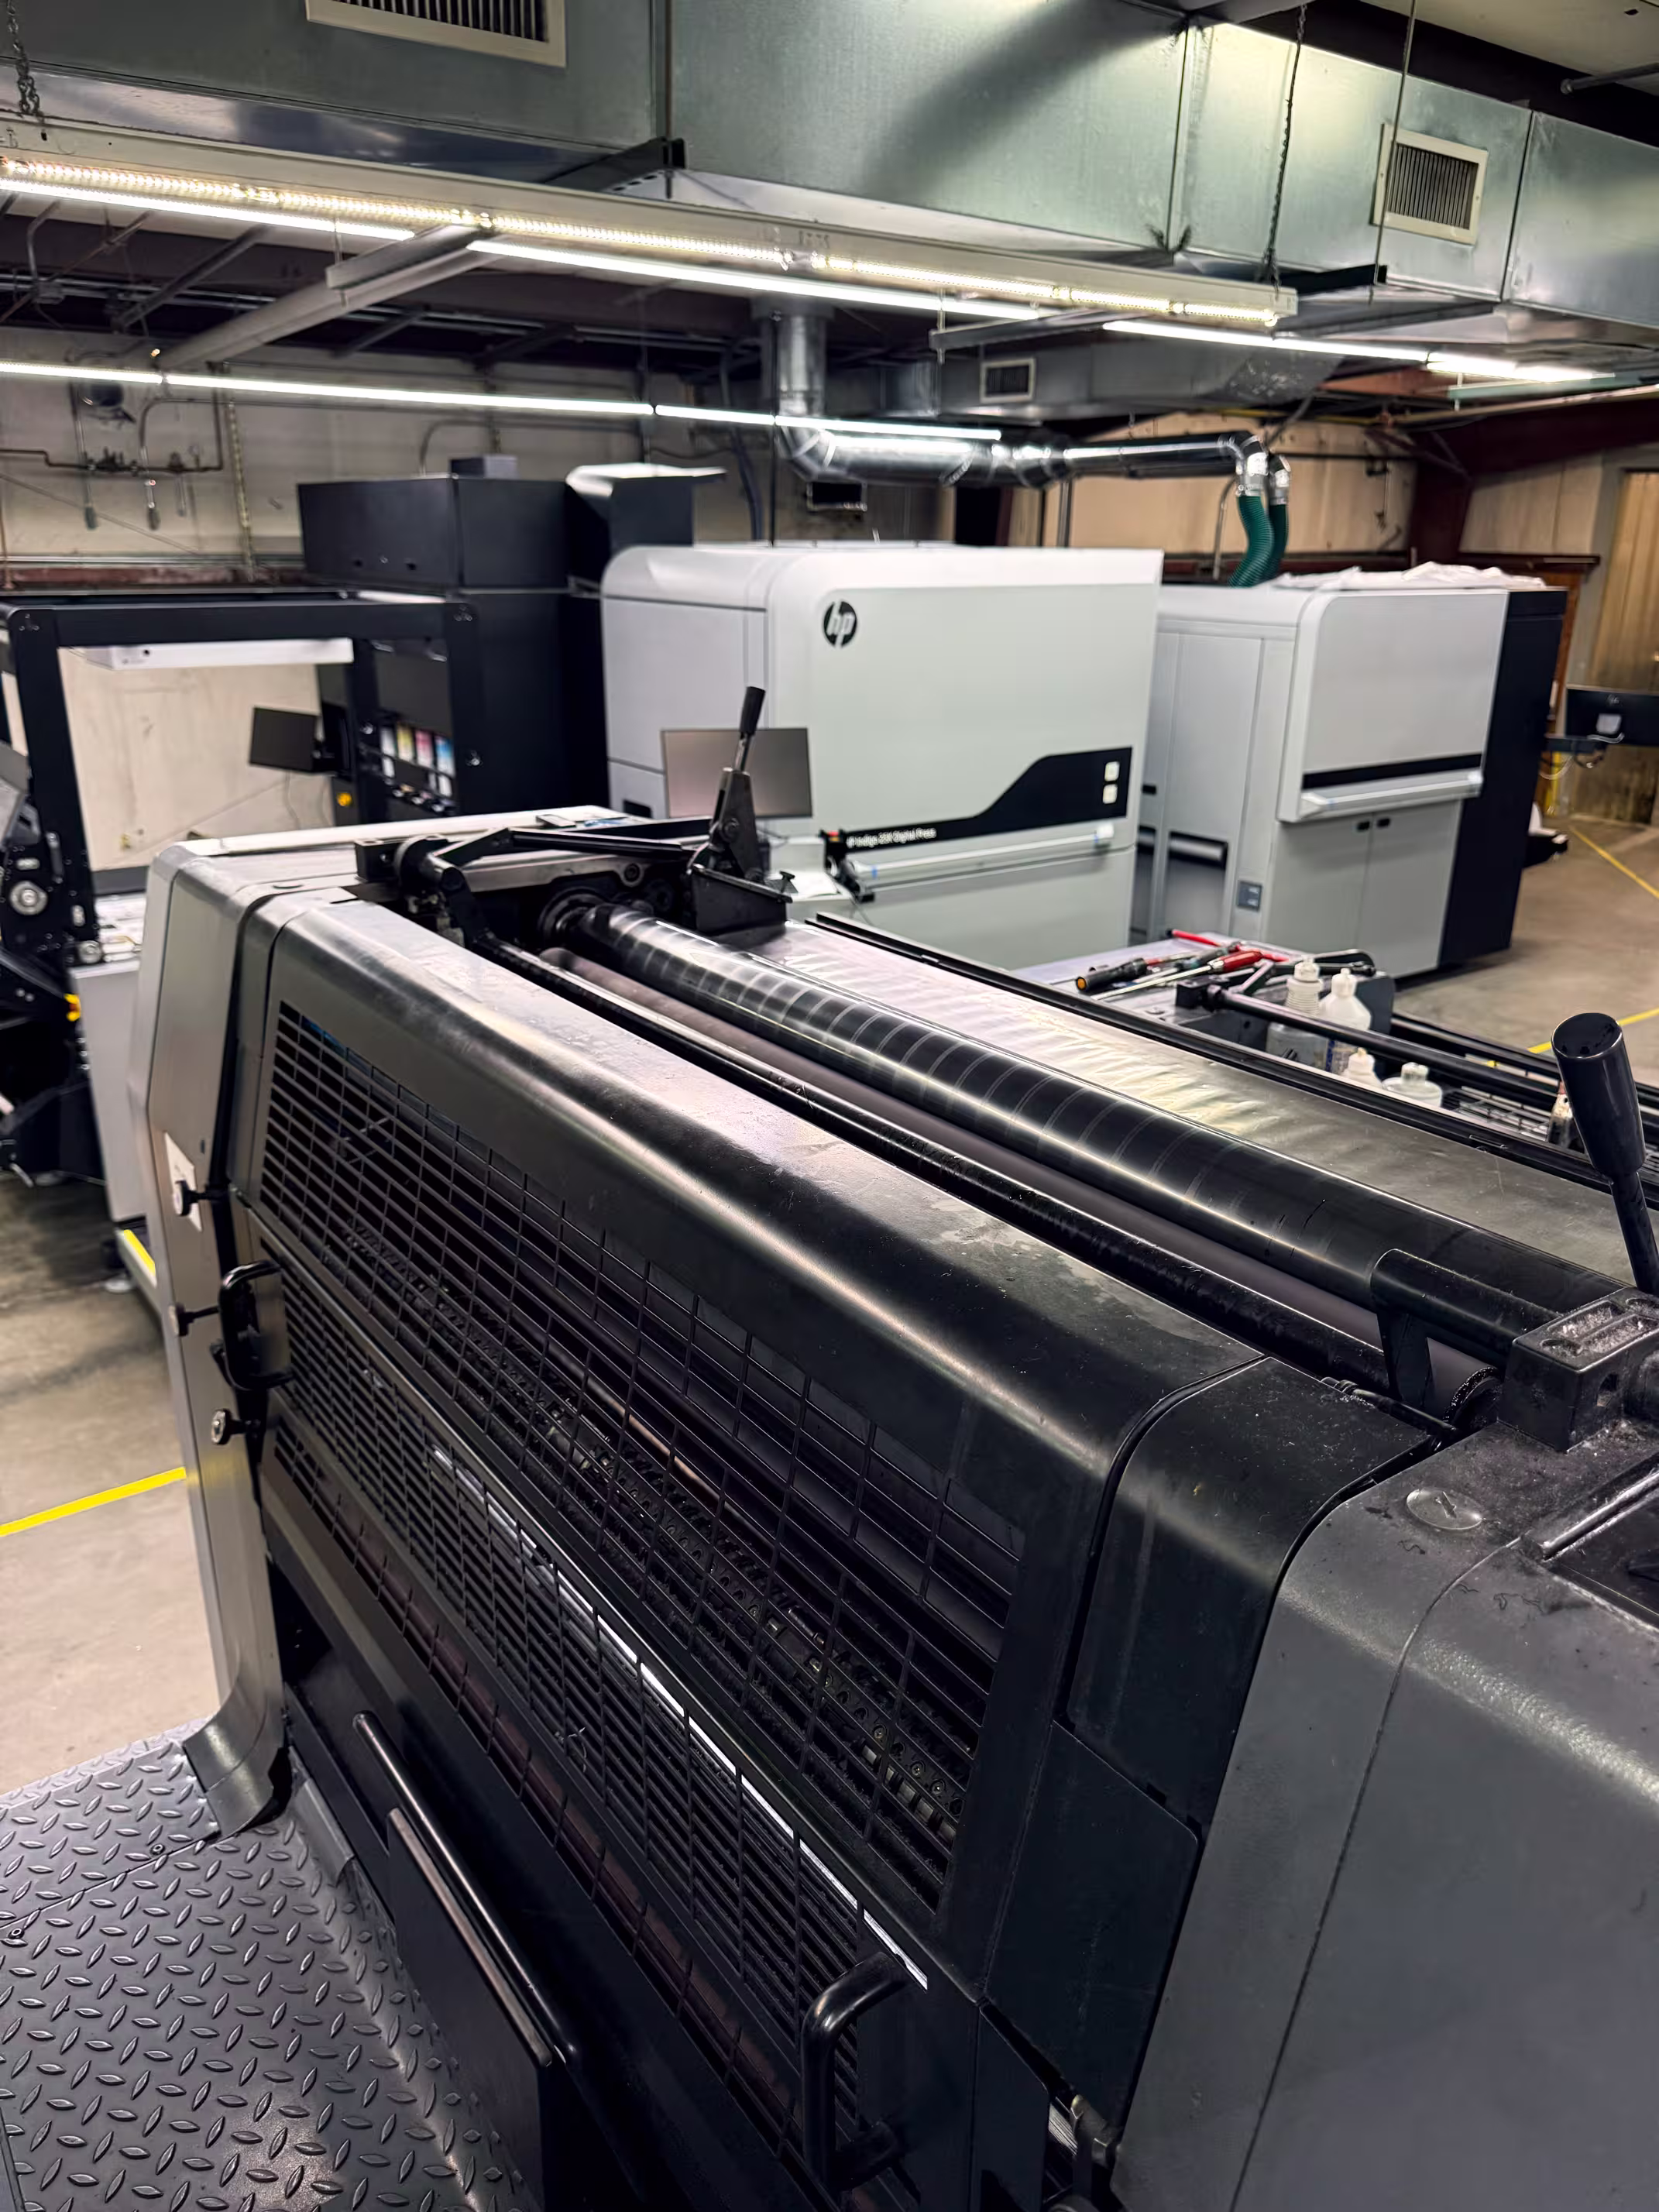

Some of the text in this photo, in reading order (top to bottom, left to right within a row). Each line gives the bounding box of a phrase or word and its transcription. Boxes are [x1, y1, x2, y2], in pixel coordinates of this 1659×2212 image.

[824, 601, 857, 647] hp
[893, 830, 915, 843] Digital
[916, 827, 936, 840] Press
